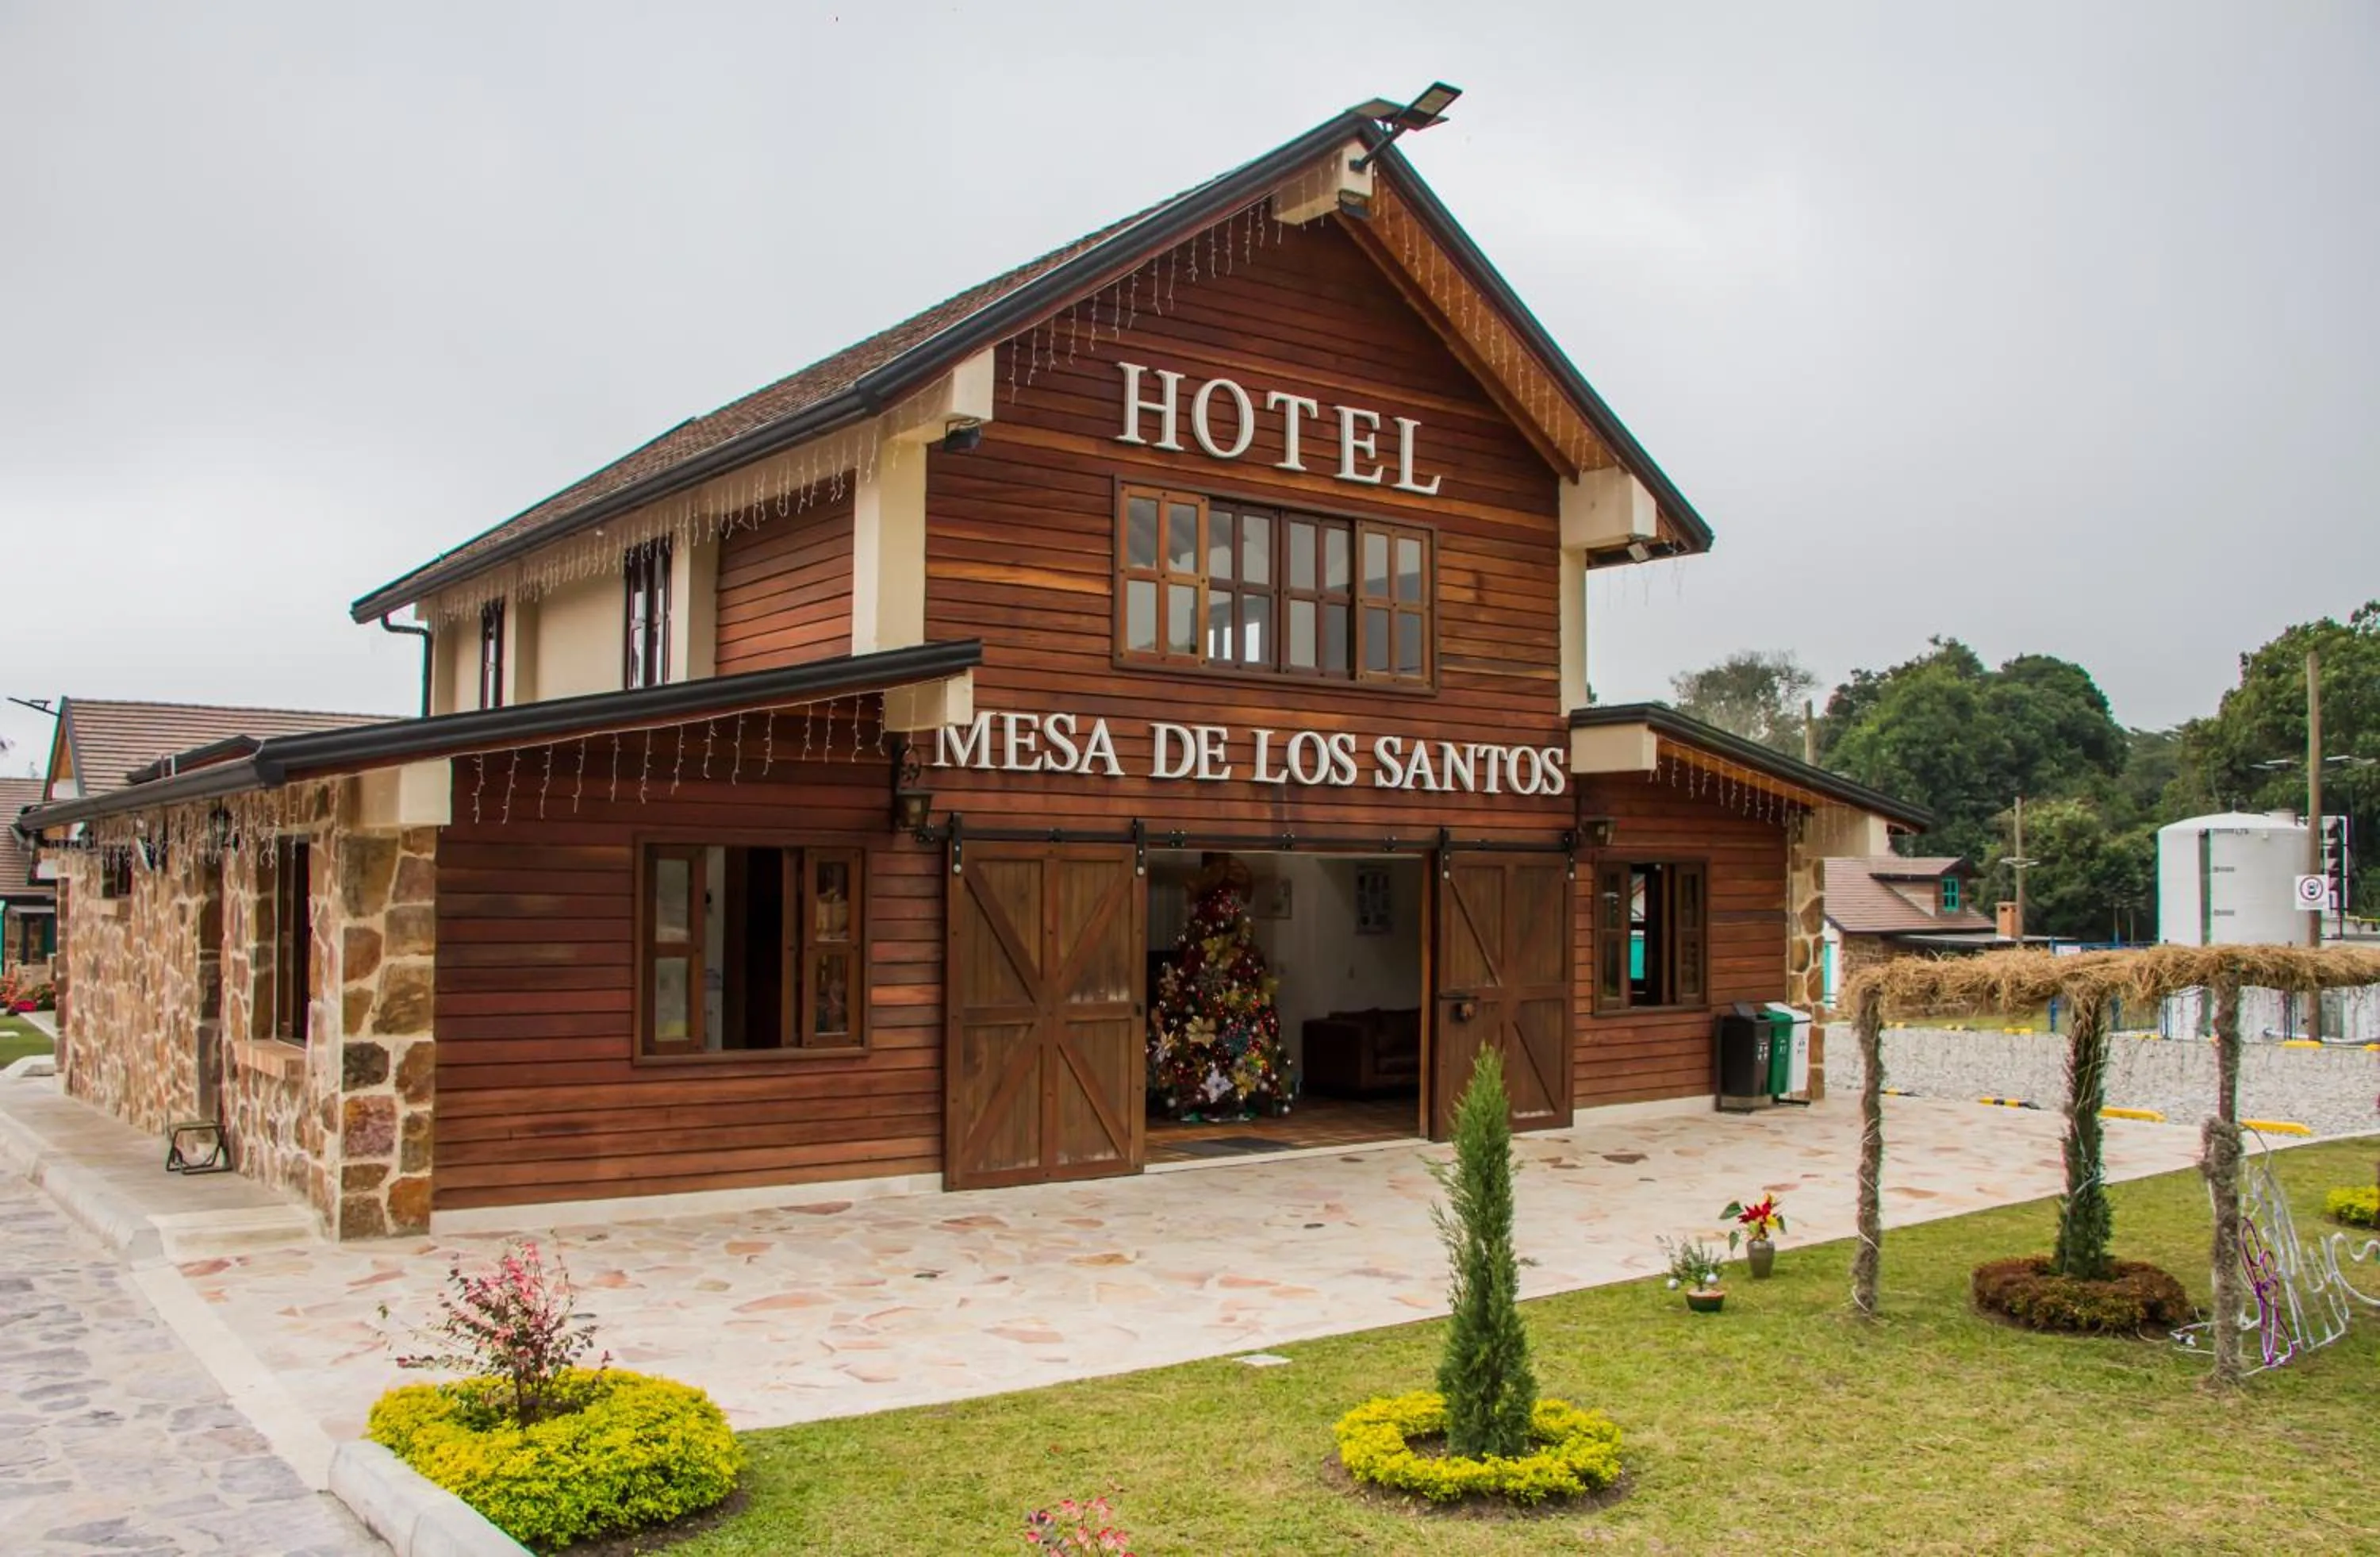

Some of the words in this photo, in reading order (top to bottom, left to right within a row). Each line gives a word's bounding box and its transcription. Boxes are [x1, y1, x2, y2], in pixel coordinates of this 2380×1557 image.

[1115, 361, 1441, 496] HOTEL
[932, 710, 1126, 776] MESA
[1148, 722, 1232, 781] DE
[1250, 729, 1358, 786] LOS
[1373, 736, 1566, 795] SANTOS
